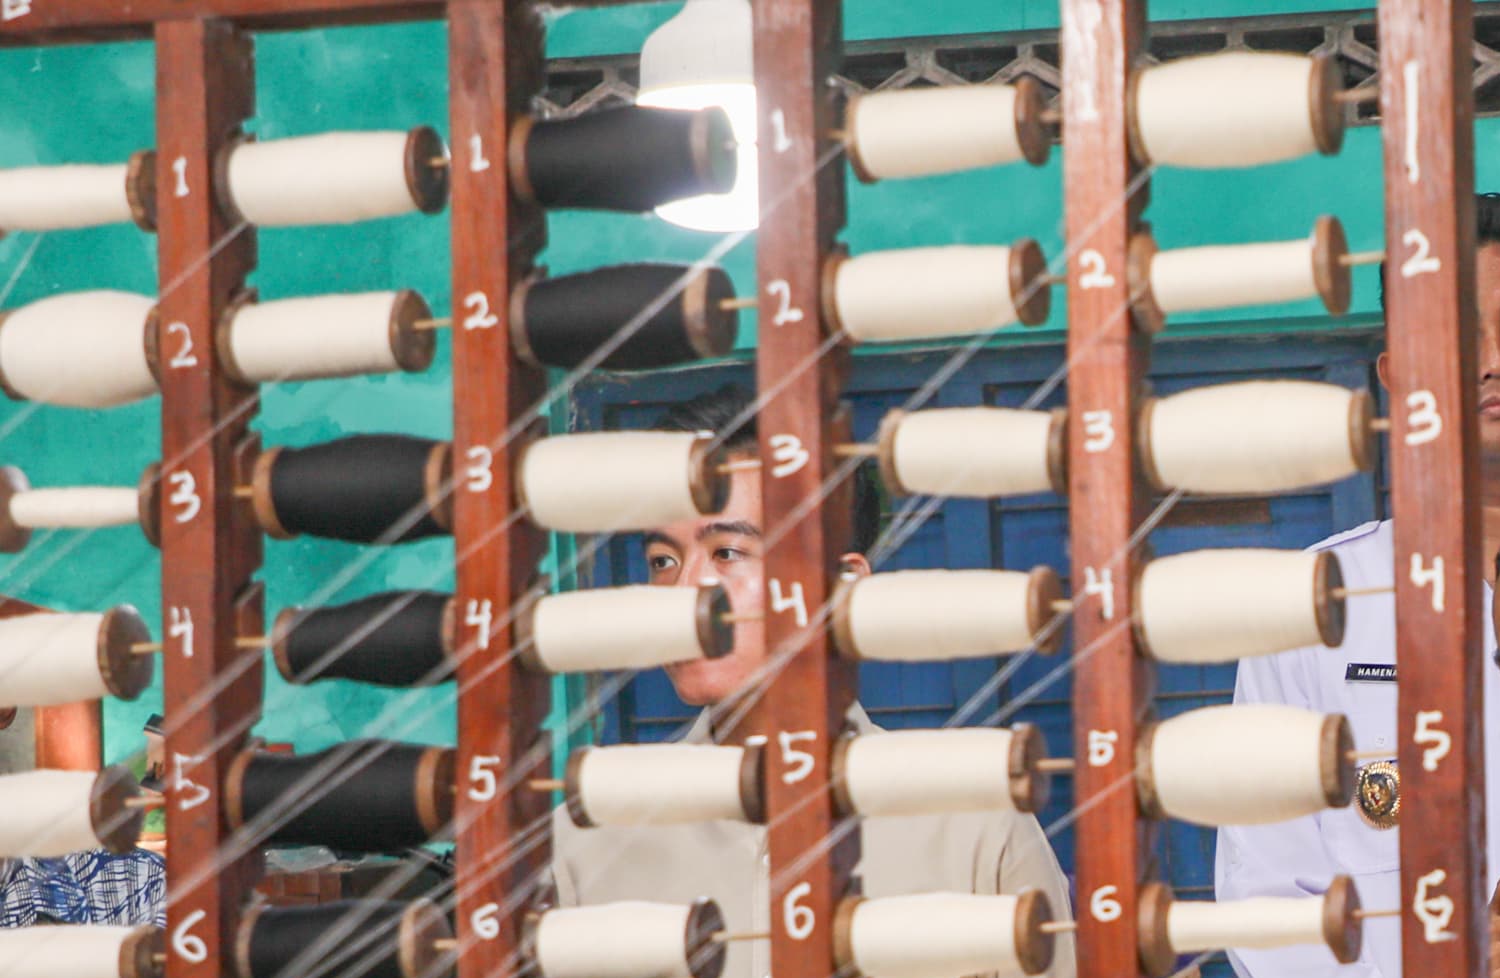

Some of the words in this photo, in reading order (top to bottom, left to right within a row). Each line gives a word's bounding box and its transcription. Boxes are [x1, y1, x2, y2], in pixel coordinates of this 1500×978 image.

[771, 109, 792, 153] 1
[1403, 59, 1420, 184] 1
[172, 156, 189, 197] 1
[469, 134, 490, 172] 1
[1079, 249, 1115, 290] 2
[1401, 228, 1441, 278] 2
[462, 291, 499, 329] 2
[766, 279, 804, 326] 2
[168, 321, 198, 368] 2
[1083, 409, 1115, 453] 3
[1404, 389, 1443, 446] 3
[466, 445, 493, 492] 3
[768, 433, 809, 478] 3
[168, 470, 201, 523] 3
[769, 578, 808, 627] 4
[1085, 566, 1115, 620] 4
[1410, 552, 1444, 613] 4
[170, 606, 194, 657] 4
[466, 599, 492, 648] 4
[779, 730, 817, 784] 5
[1088, 730, 1118, 766] 5
[1413, 710, 1451, 772] 5
[468, 755, 500, 801] 5
[469, 903, 500, 940] 6
[783, 883, 815, 940] 6
[1090, 885, 1121, 922] 6
[172, 910, 207, 963] 6
